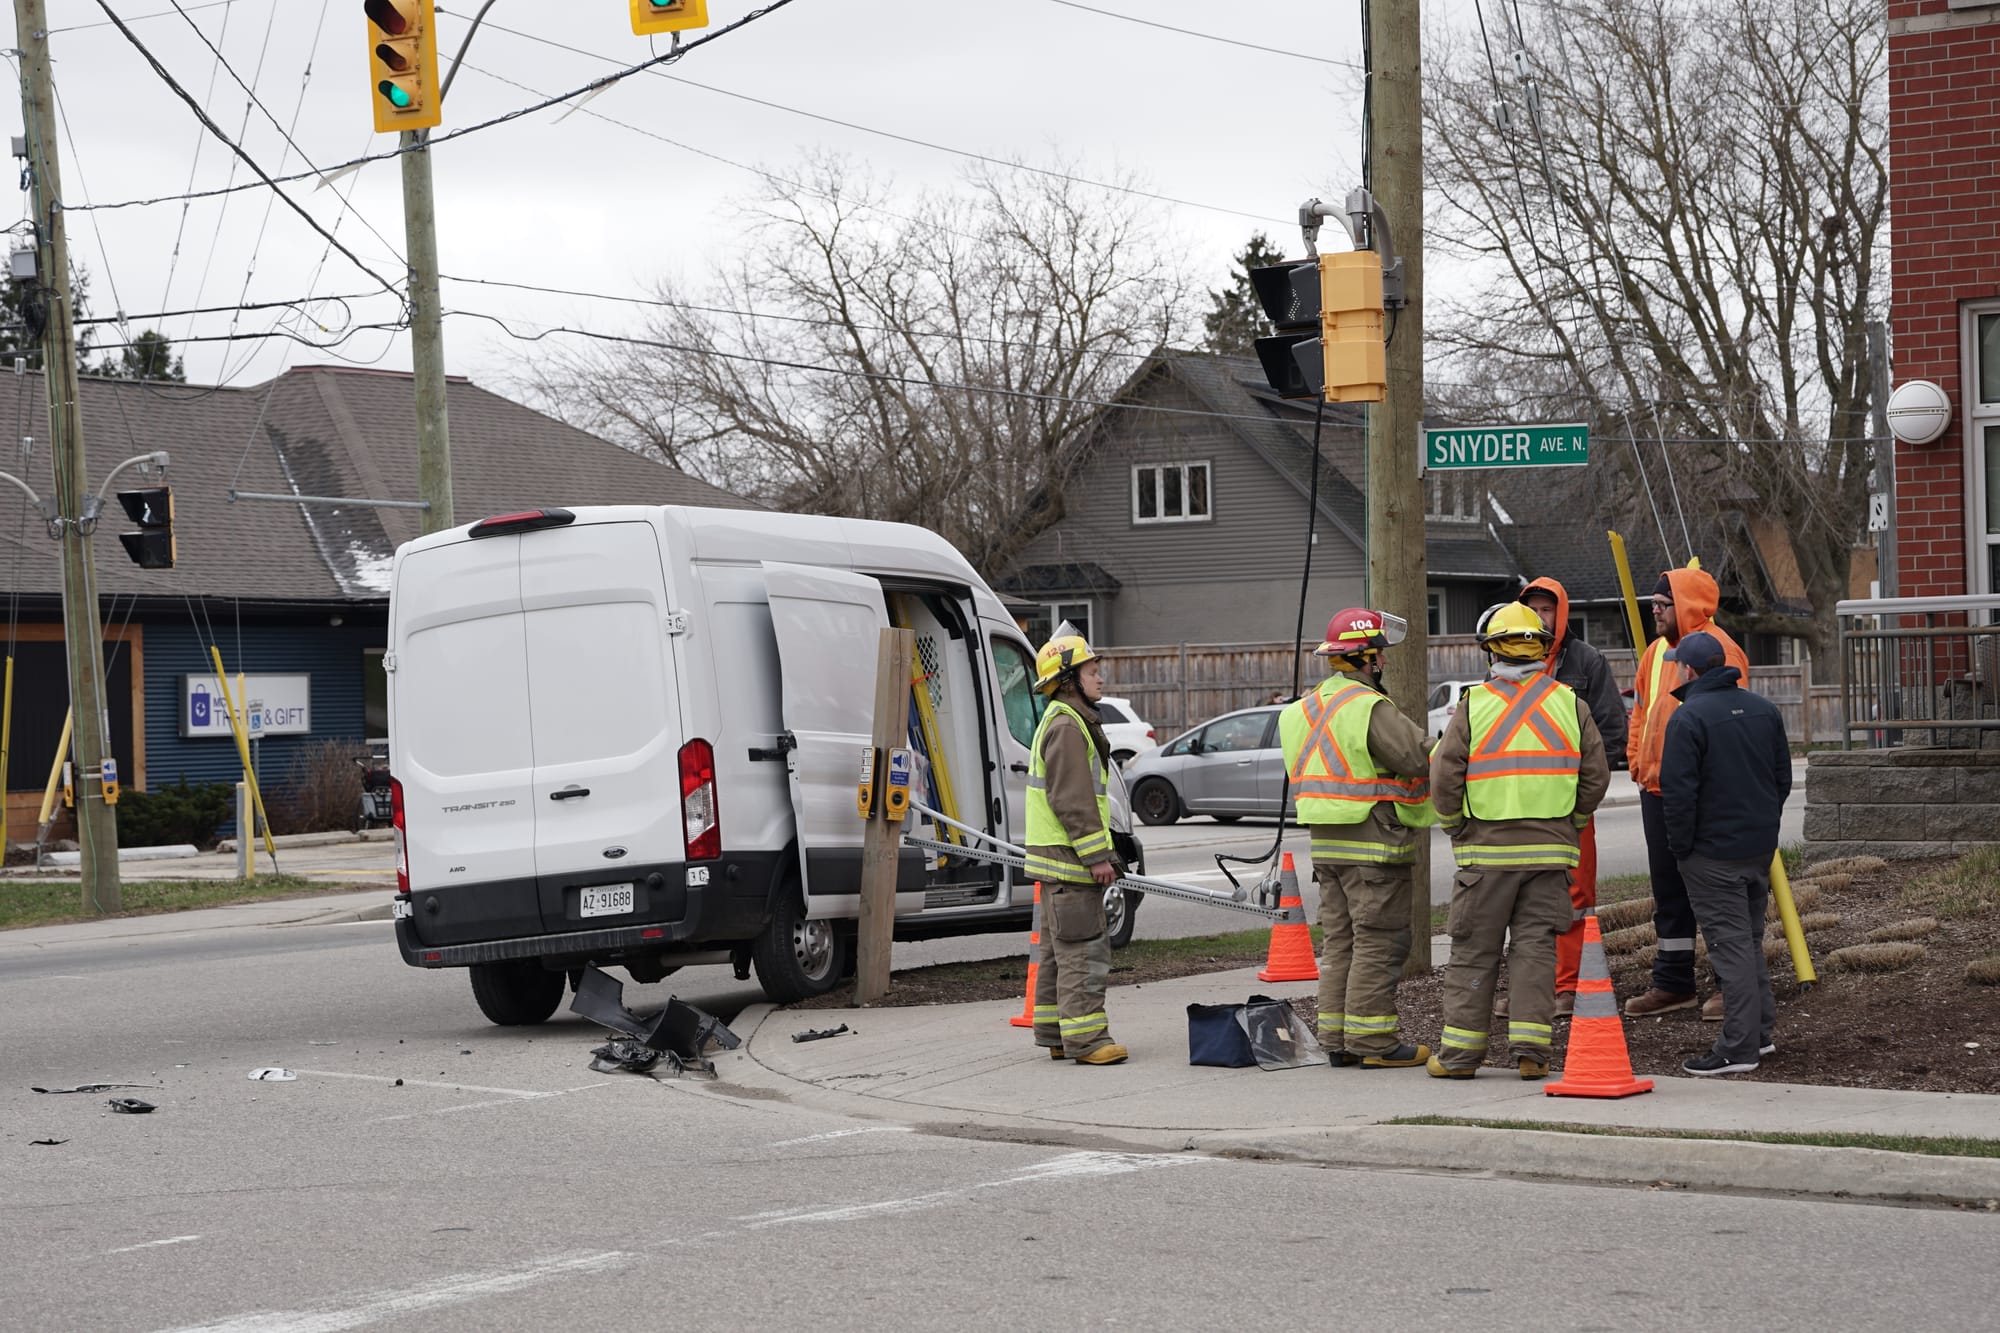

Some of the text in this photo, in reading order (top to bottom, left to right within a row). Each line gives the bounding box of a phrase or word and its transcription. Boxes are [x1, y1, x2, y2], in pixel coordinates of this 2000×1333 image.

[1434, 432, 1586, 463] SNYDER AVE. N.
[1350, 620, 1373, 631] 104
[1046, 644, 1066, 658] 120
[264, 709, 273, 726] &
[275, 708, 305, 726] GIFT
[441, 801, 498, 813] TRANSIT
[583, 891, 631, 910] AZ 91688
